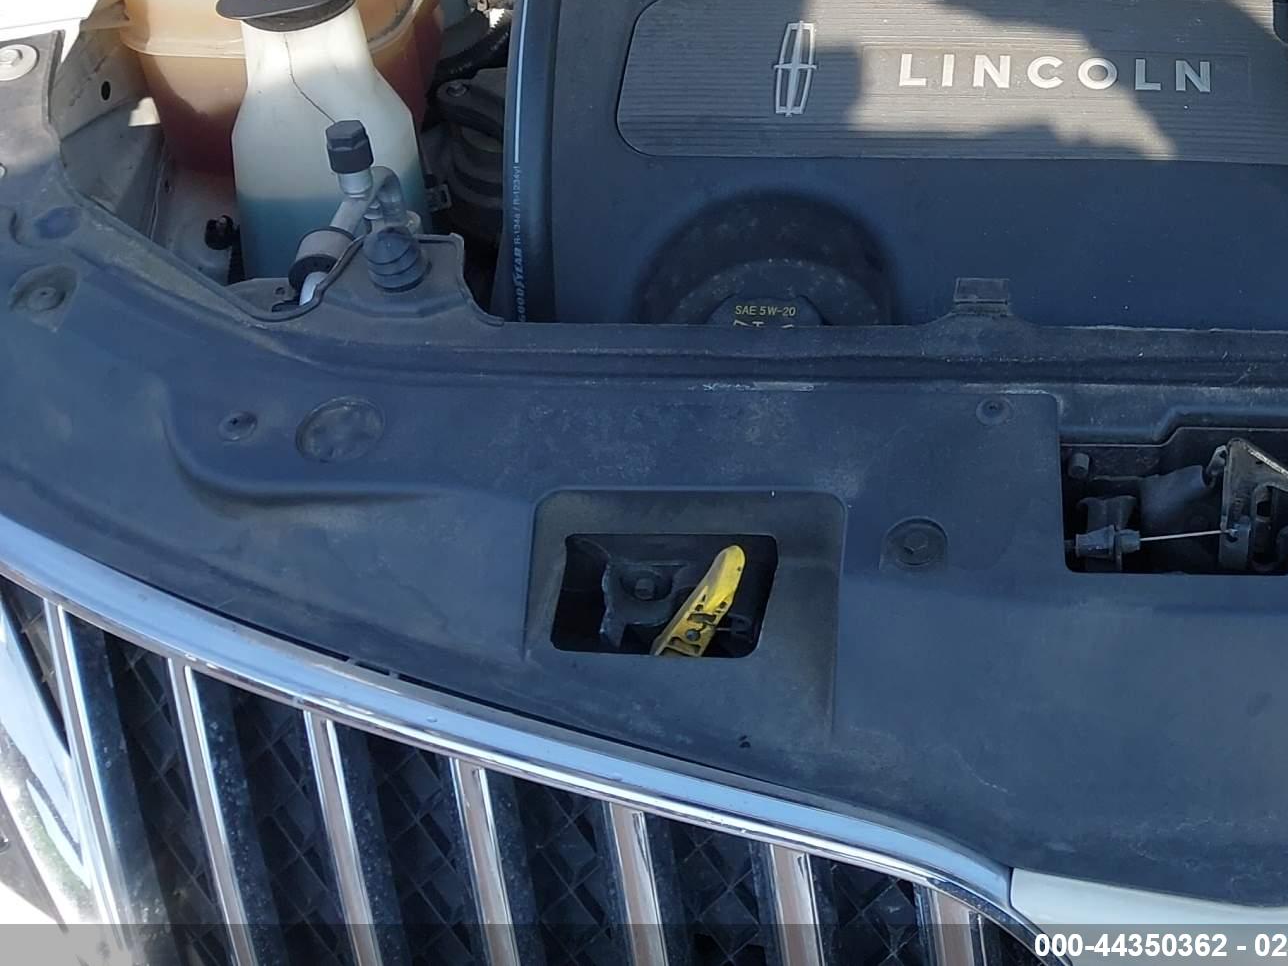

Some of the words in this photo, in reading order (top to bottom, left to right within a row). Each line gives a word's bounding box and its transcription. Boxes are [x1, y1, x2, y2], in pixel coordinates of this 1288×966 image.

[898, 53, 1212, 93] LINCOLN
[735, 305, 757, 316] SAE
[760, 306, 796, 317] 5W-20
